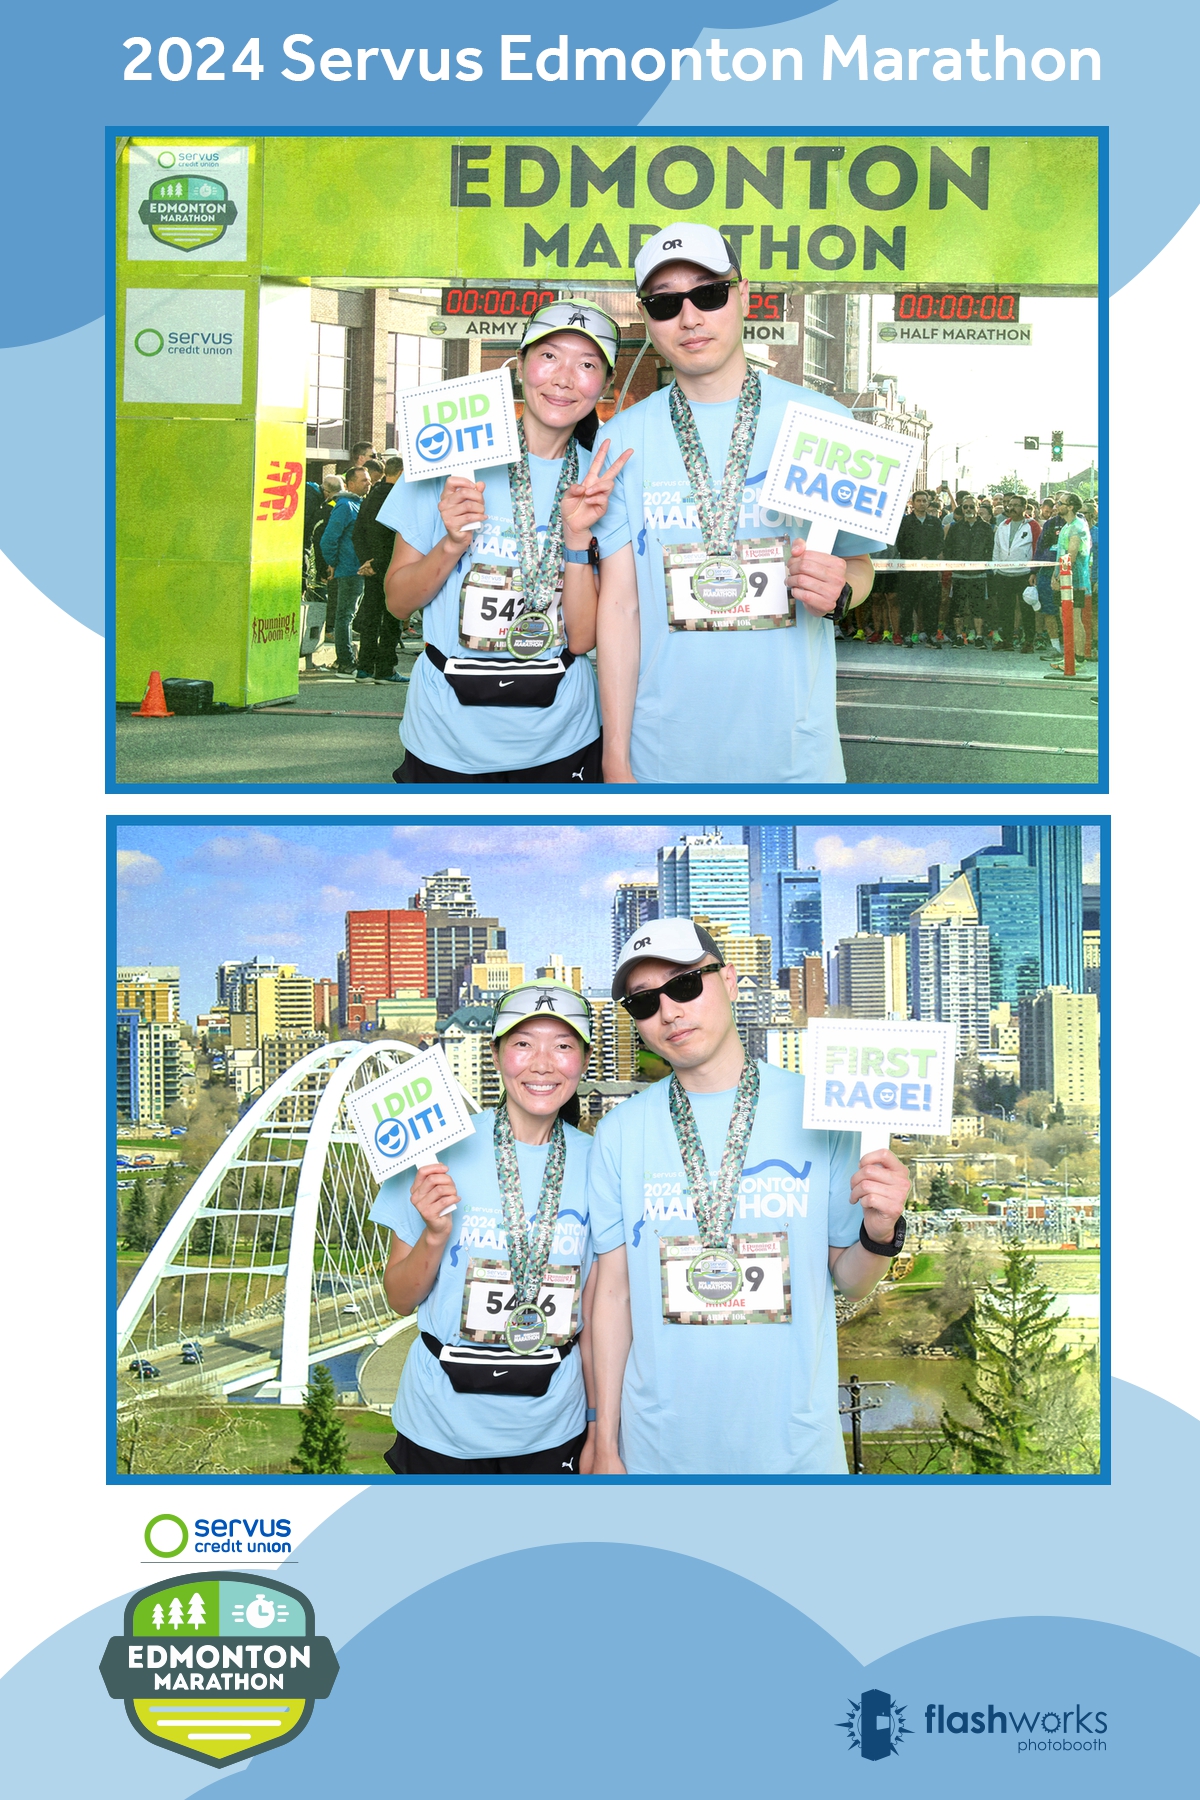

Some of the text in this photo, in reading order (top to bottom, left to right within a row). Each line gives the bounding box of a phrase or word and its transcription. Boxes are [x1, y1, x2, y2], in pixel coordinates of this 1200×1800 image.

[178, 152, 219, 161] servus
[450, 144, 990, 211] EDMONTON
[149, 203, 226, 213] EDMONTON
[160, 214, 215, 222] MARATHON
[662, 238, 683, 251] OR
[465, 321, 518, 335] ARMY
[900, 327, 939, 339] HALF
[943, 329, 1031, 341] MARATHON
[168, 332, 233, 345] servus
[168, 345, 233, 355] credit union
[422, 394, 490, 426] I DID
[455, 422, 494, 452] IT!
[792, 431, 900, 485] FIRST
[643, 491, 681, 506] 2024
[784, 464, 888, 518] RACE!
[712, 619, 734, 628] ARMY
[633, 936, 652, 951] OR
[825, 1045, 938, 1078] FIRST
[371, 1077, 433, 1124] I DID
[824, 1079, 932, 1112] RACE!
[408, 1103, 446, 1141] IT!
[643, 1182, 682, 1197] 2024
[462, 1215, 496, 1229] 2024
[706, 1313, 729, 1321] ARMY
